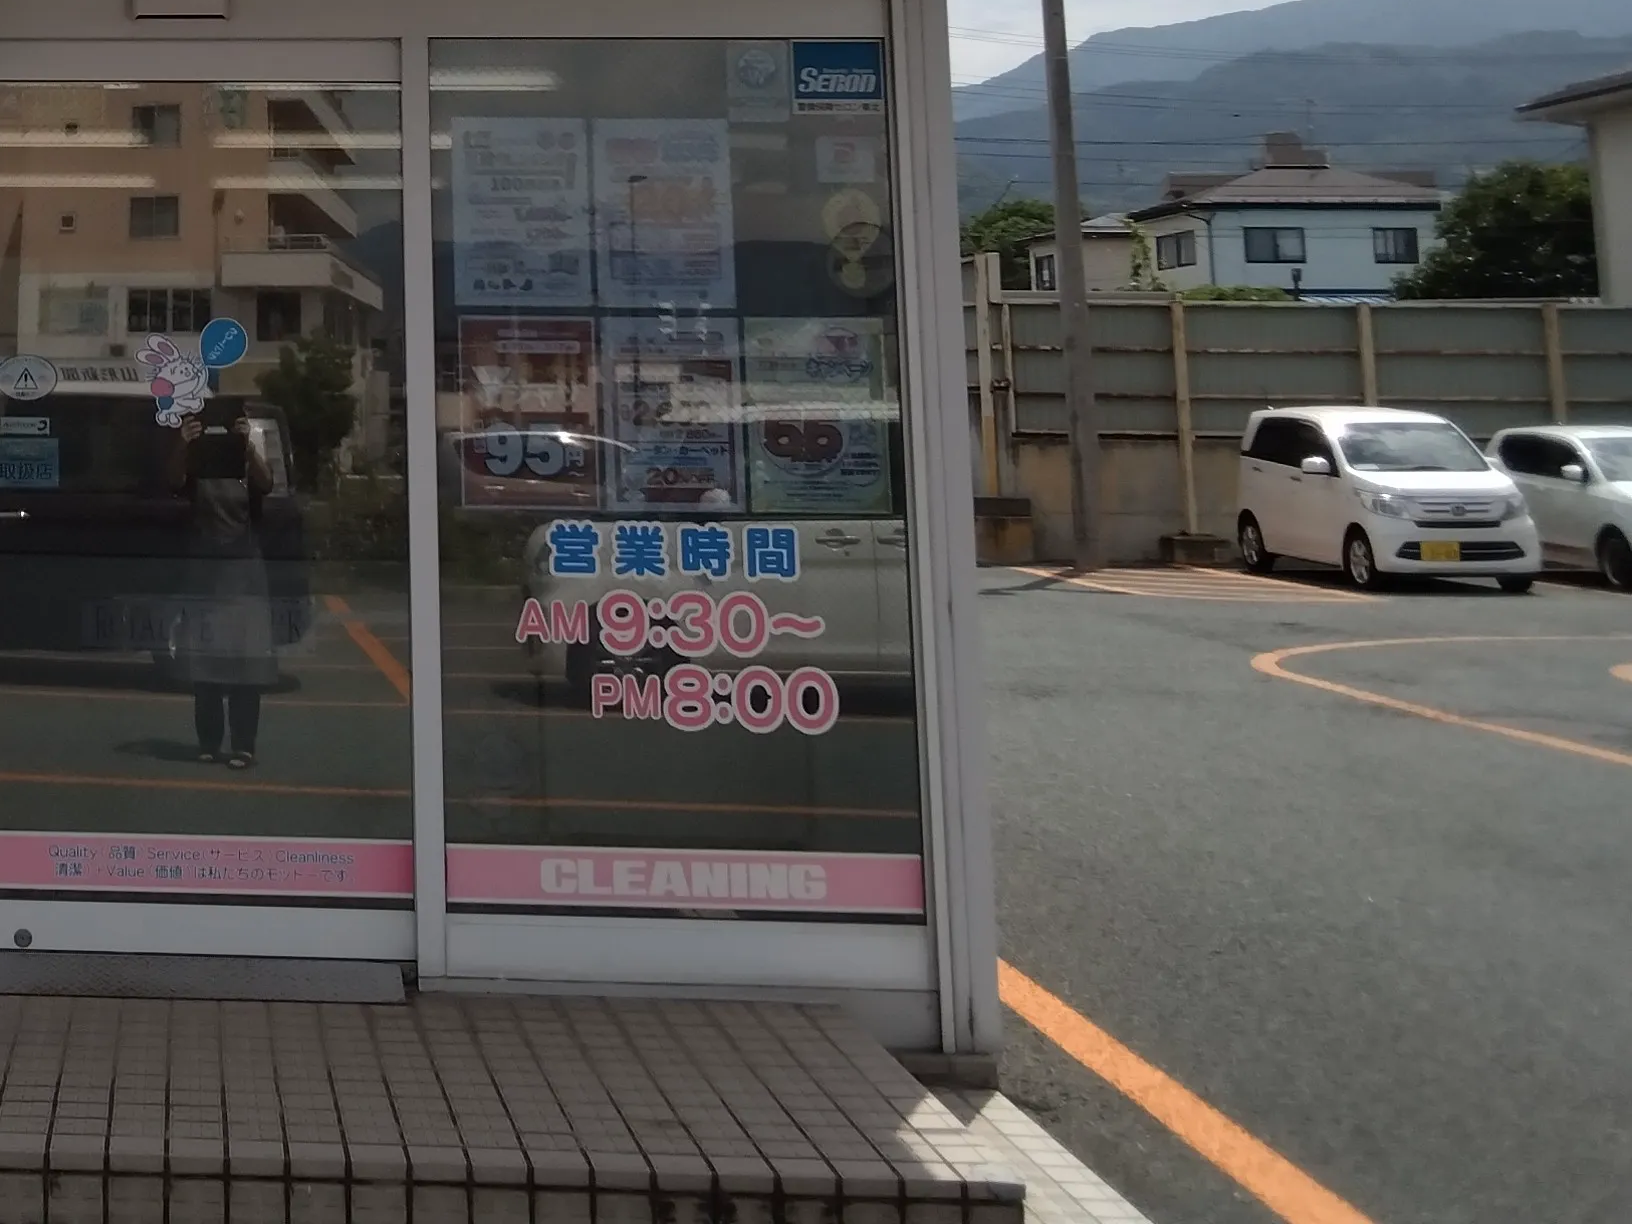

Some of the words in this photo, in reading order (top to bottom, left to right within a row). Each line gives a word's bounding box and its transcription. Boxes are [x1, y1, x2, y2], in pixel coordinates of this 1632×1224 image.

[546, 520, 800, 583] 営業時間
[515, 598, 589, 644] AM
[540, 858, 827, 901] CLEANING
